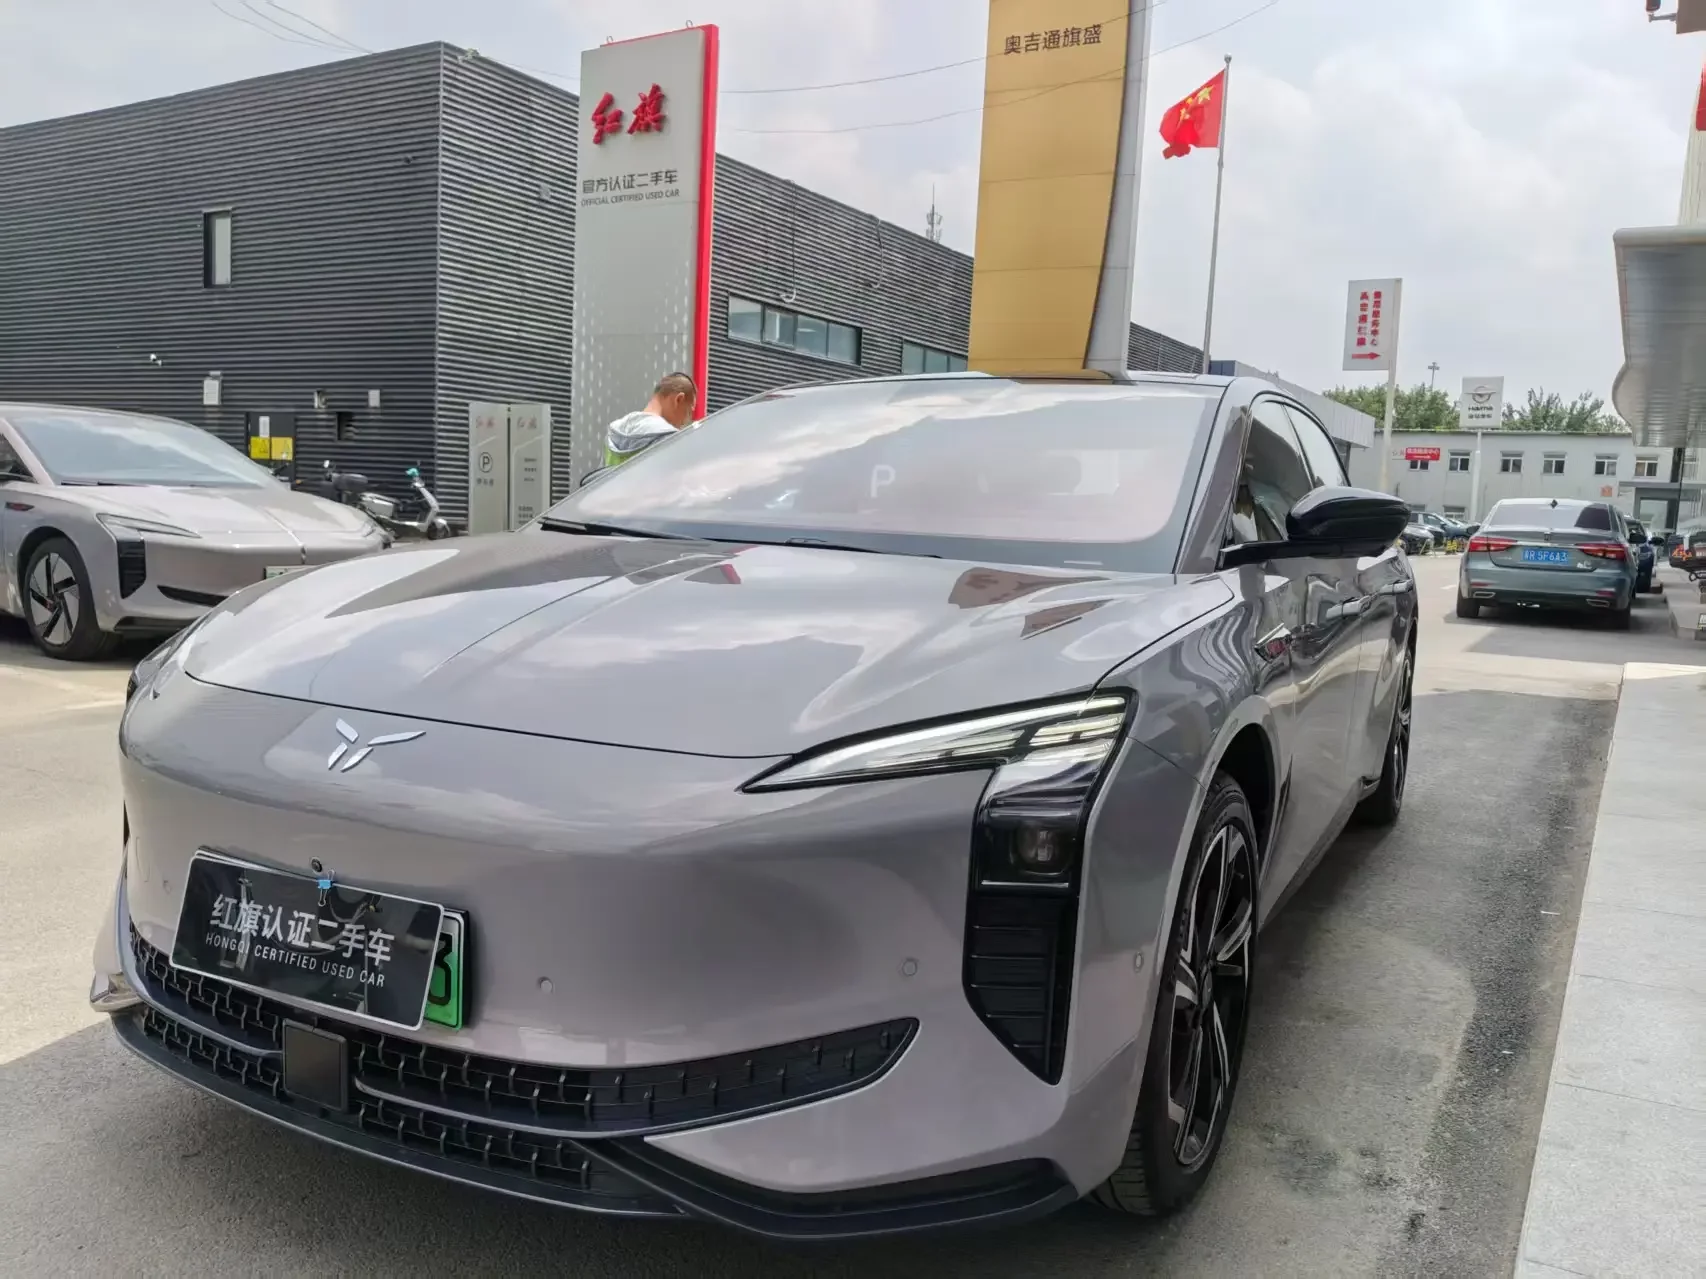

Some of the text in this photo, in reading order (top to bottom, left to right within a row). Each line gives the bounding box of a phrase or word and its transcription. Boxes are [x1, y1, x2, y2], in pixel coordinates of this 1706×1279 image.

[1003, 23, 1101, 55] 奥吉通旗盛
[591, 83, 666, 145] 红旗
[582, 171, 678, 193] 官方认证二手车
[610, 193, 643, 205] CERTIFIED
[645, 191, 663, 201] USED
[664, 188, 680, 198] CAR
[871, 464, 896, 498] P
[210, 894, 395, 966] 红旗认证二手车
[205, 932, 385, 988] HONGQI CERTIFIED USED CAR
